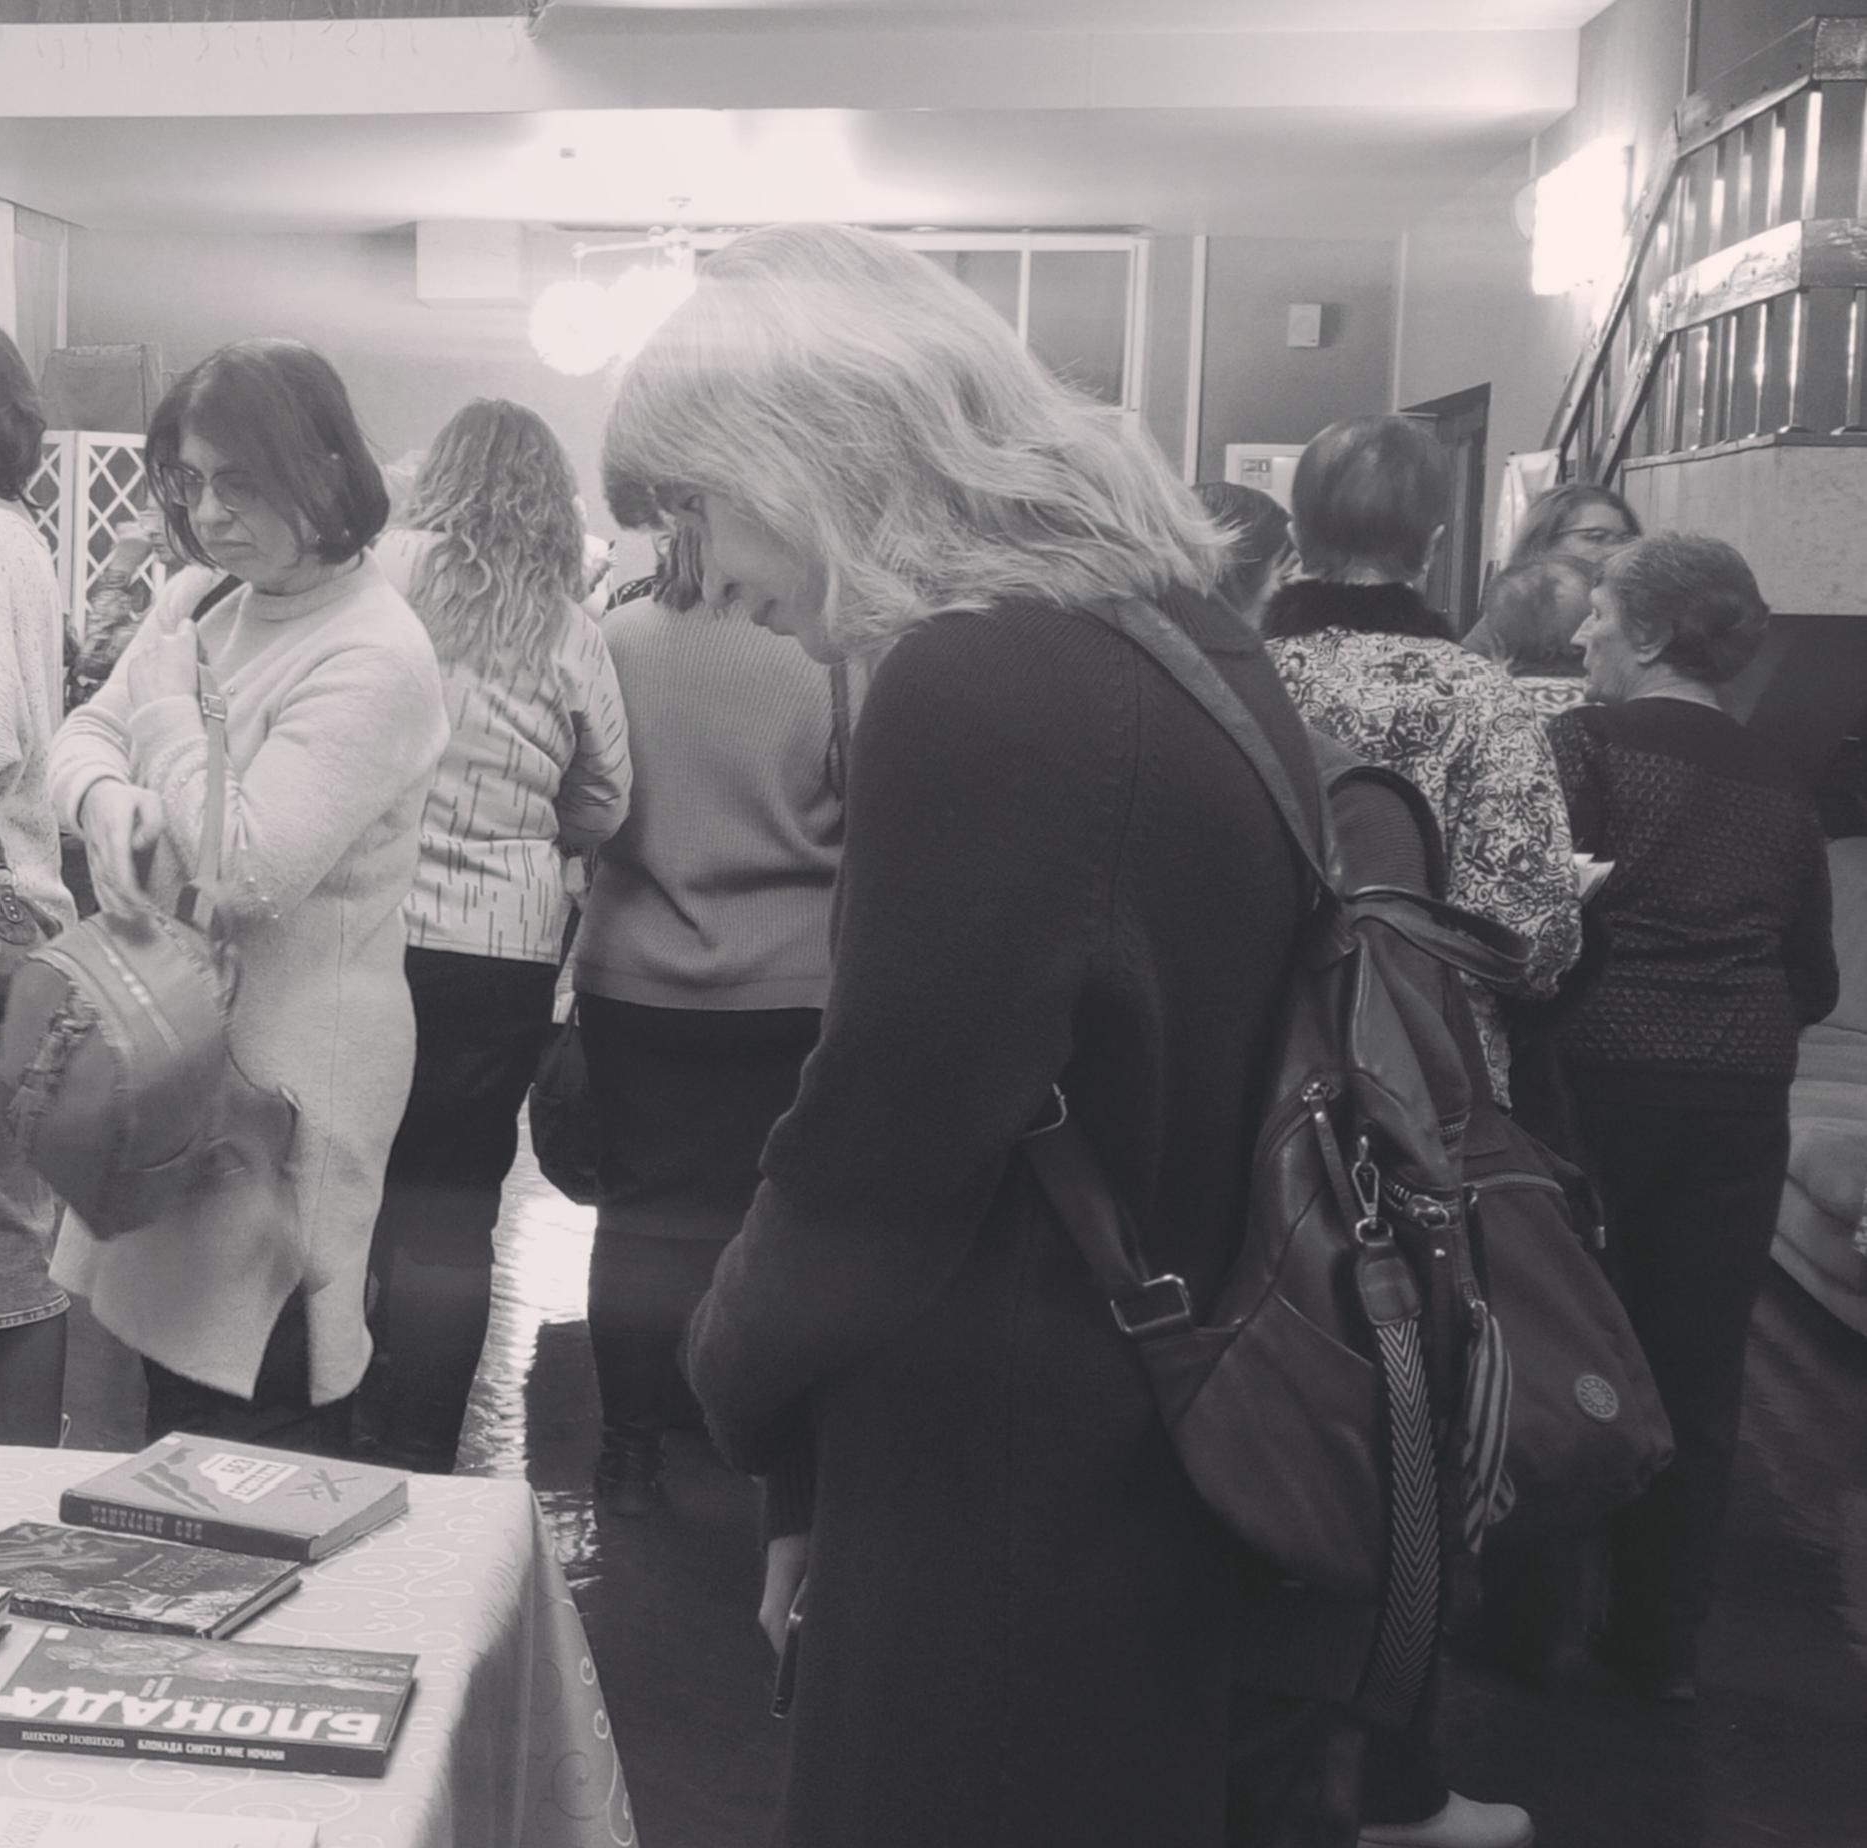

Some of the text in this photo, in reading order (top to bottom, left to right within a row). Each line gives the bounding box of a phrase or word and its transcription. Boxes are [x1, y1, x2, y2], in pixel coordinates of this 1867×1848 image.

[21, 1730, 125, 1748] ВИКТОР НОВИКОВ
[137, 1738, 286, 1761] БЛОКАДА СНИТСЯ МНЕ НОЧАМИ
